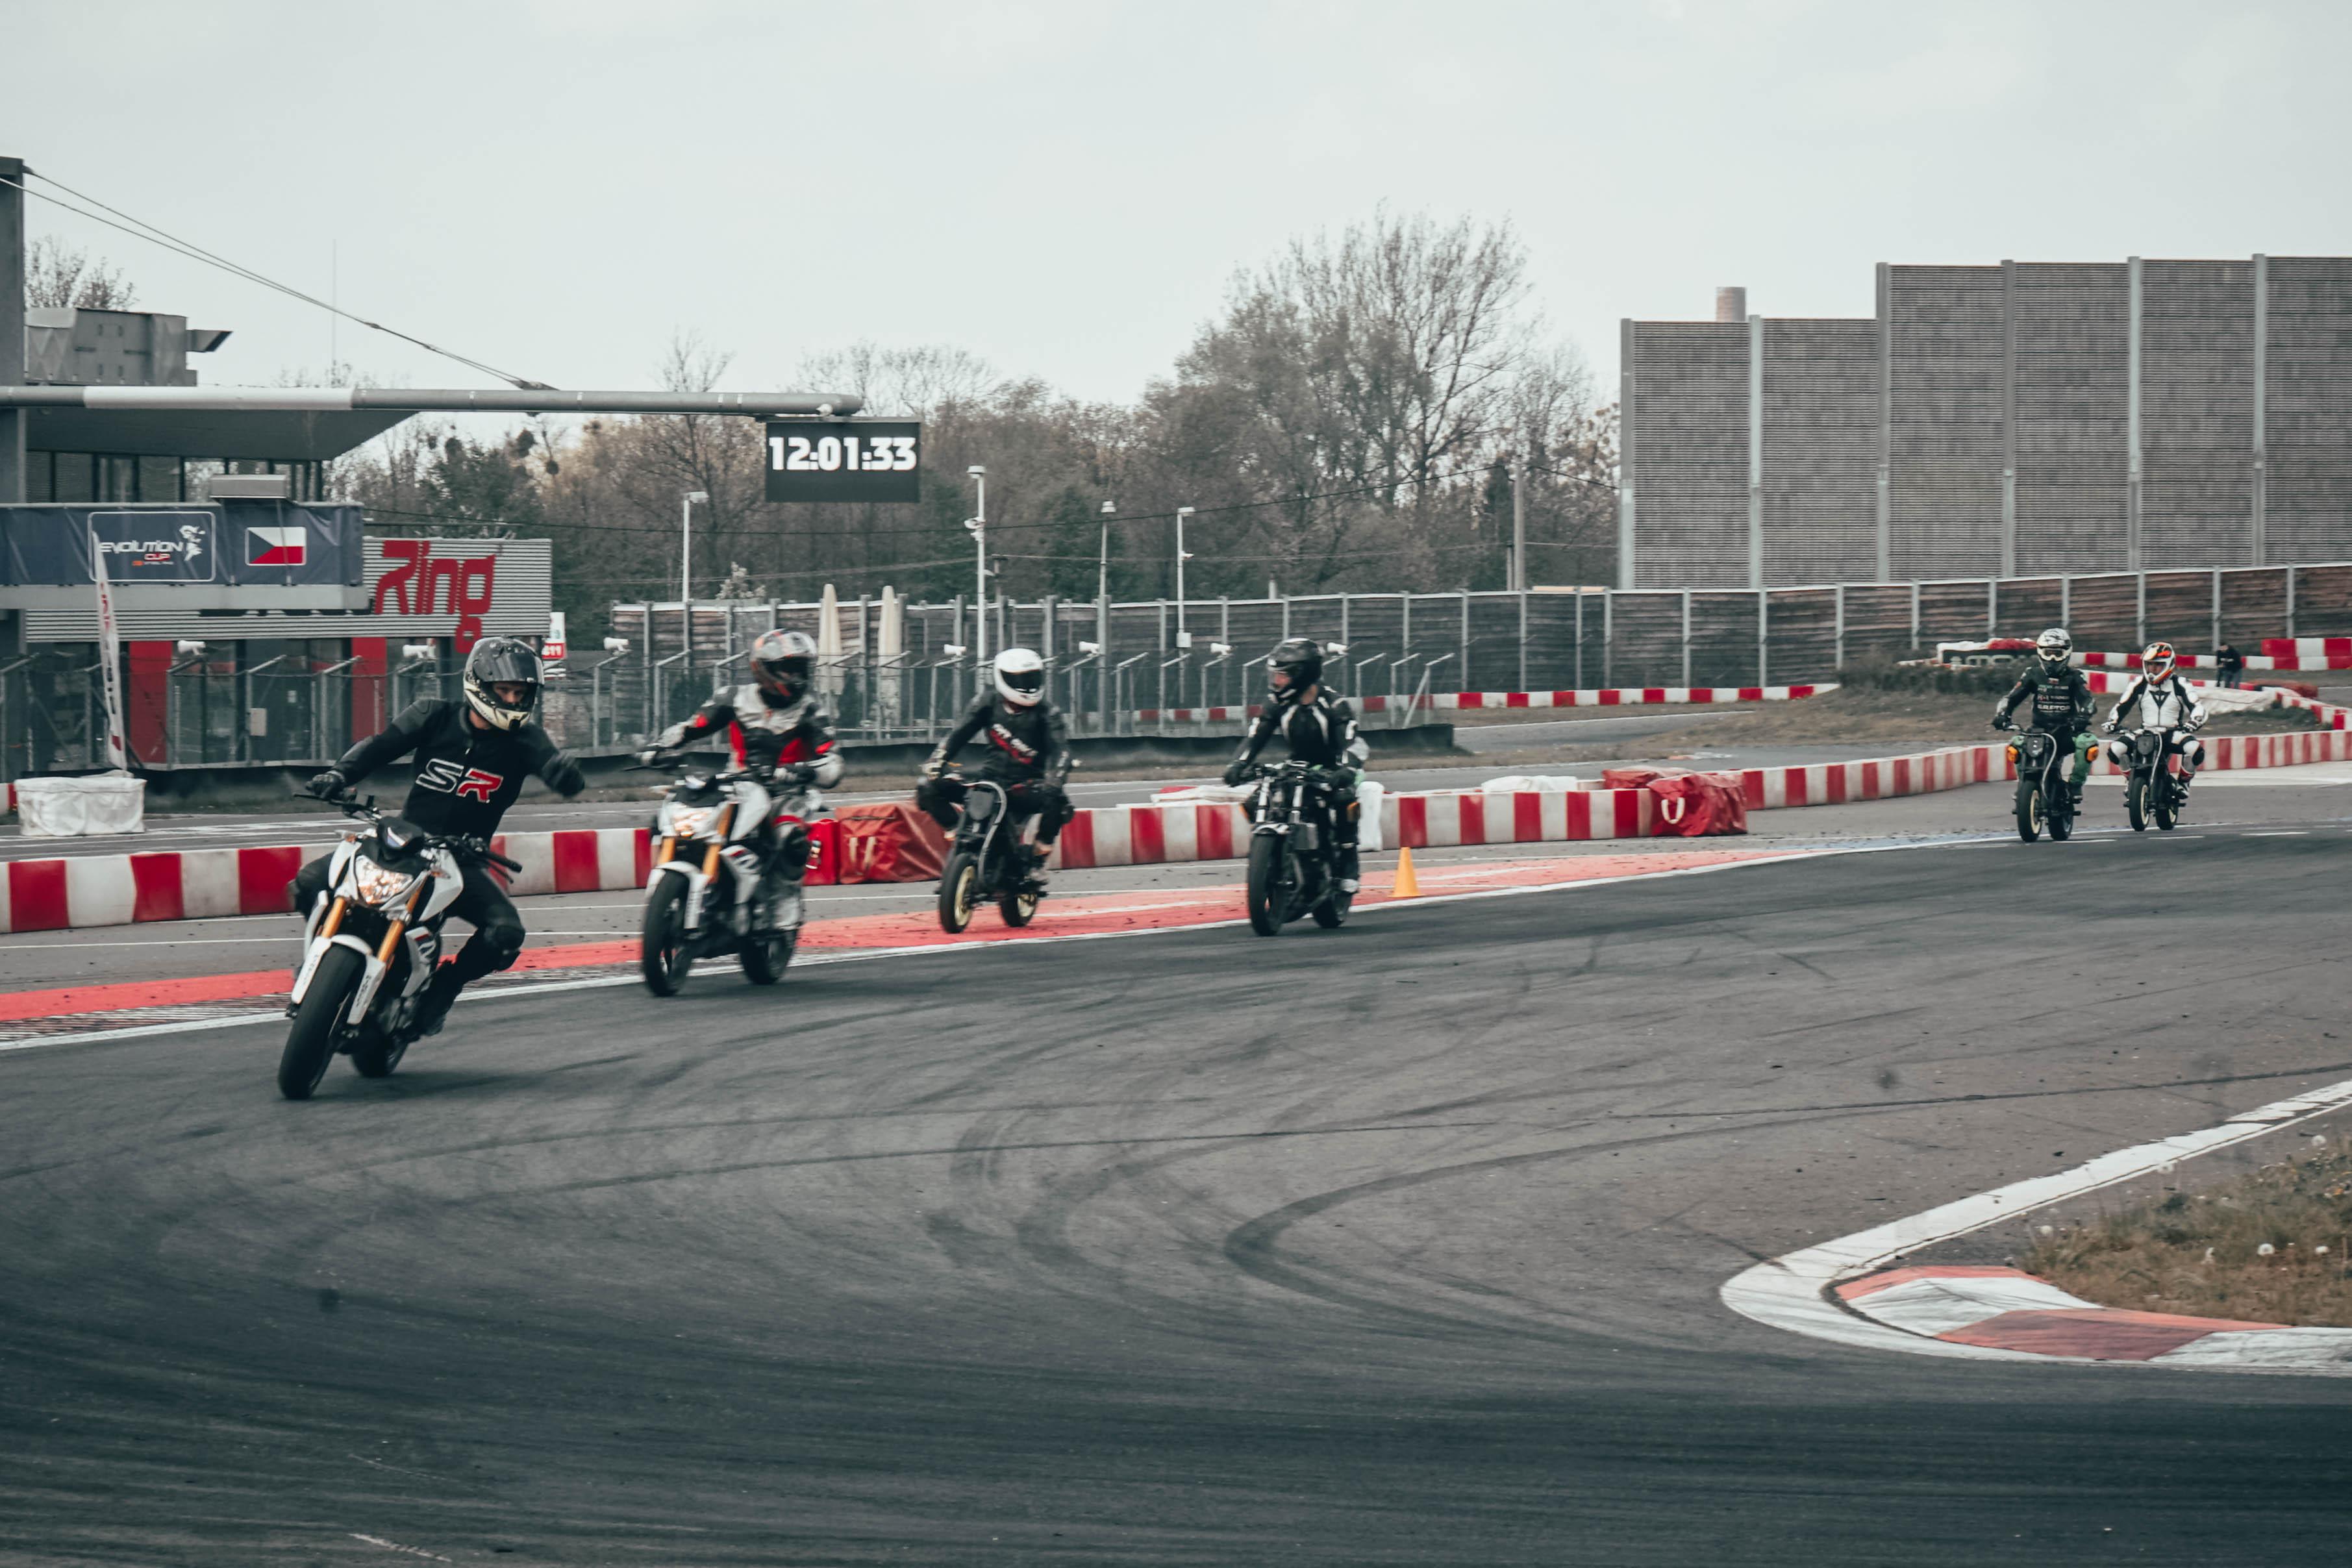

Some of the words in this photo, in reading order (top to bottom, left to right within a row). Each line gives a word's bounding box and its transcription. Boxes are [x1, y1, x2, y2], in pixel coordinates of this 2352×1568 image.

[769, 436, 917, 470] 12:01:33
[374, 540, 495, 653] Ring
[416, 758, 503, 803] SR
